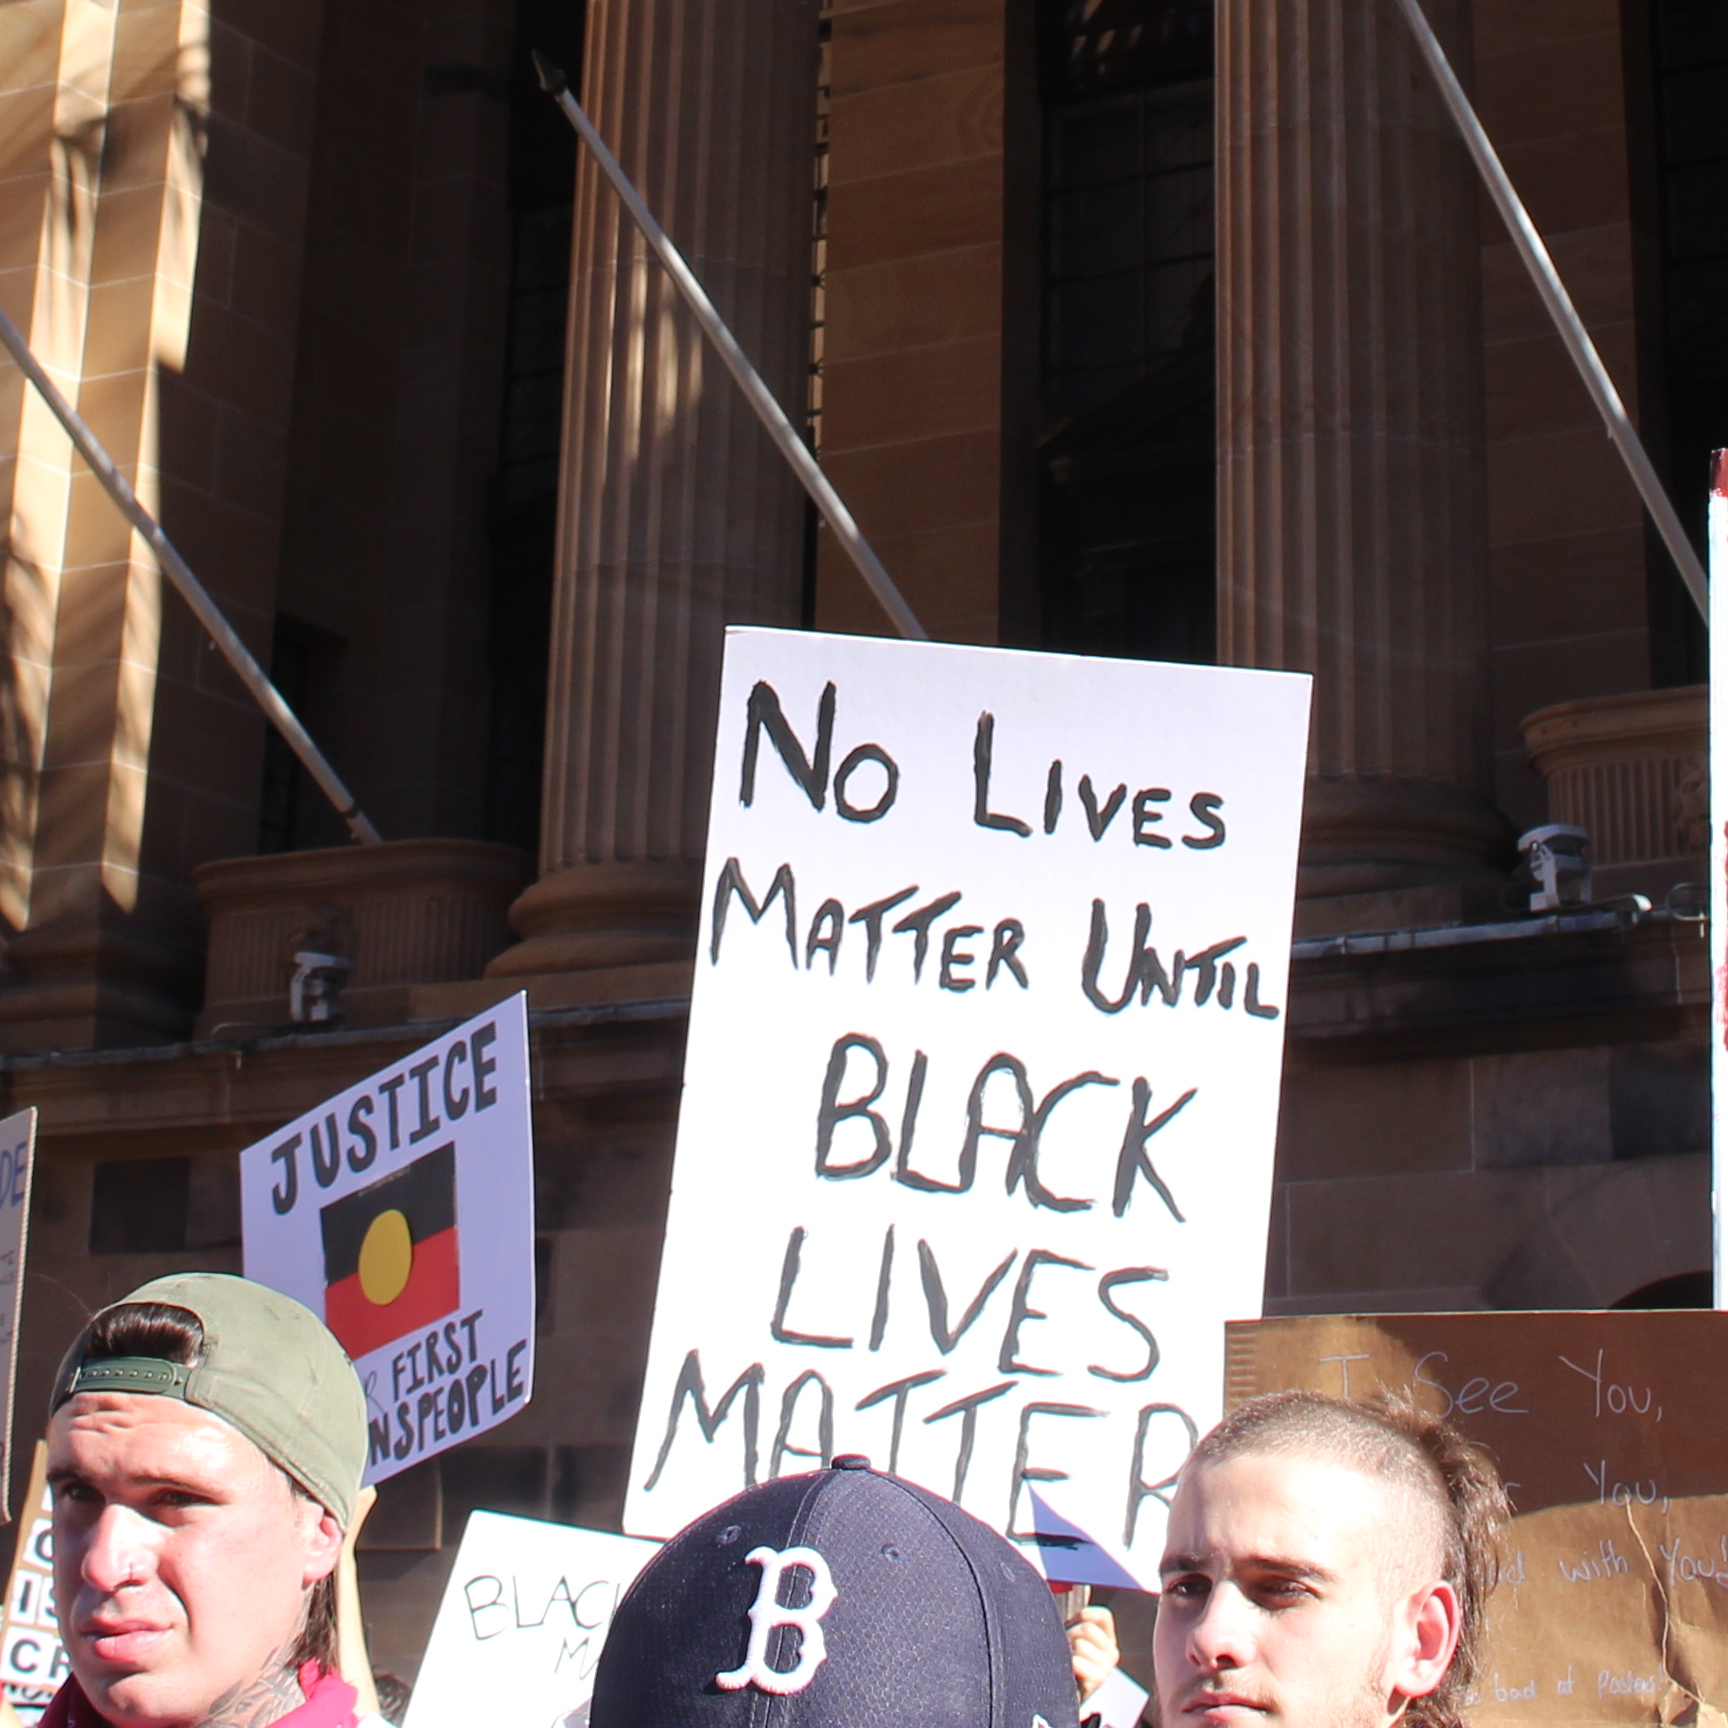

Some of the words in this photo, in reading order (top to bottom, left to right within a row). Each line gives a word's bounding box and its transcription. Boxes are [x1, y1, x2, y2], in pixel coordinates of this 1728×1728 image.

[708, 855, 1031, 994] MATTER
[1082, 899, 1280, 1020] UNTIL
[271, 1020, 497, 1216] JUSTICE
[815, 1031, 1200, 1224] BLACK
[391, 1308, 484, 1404] FIRST
[768, 1222, 1171, 1384] LIVES
[643, 1348, 1200, 1548] MATTER
[1414, 1351, 1529, 1420] See
[715, 1545, 839, 1696] B
[1558, 1538, 1630, 1583] with
